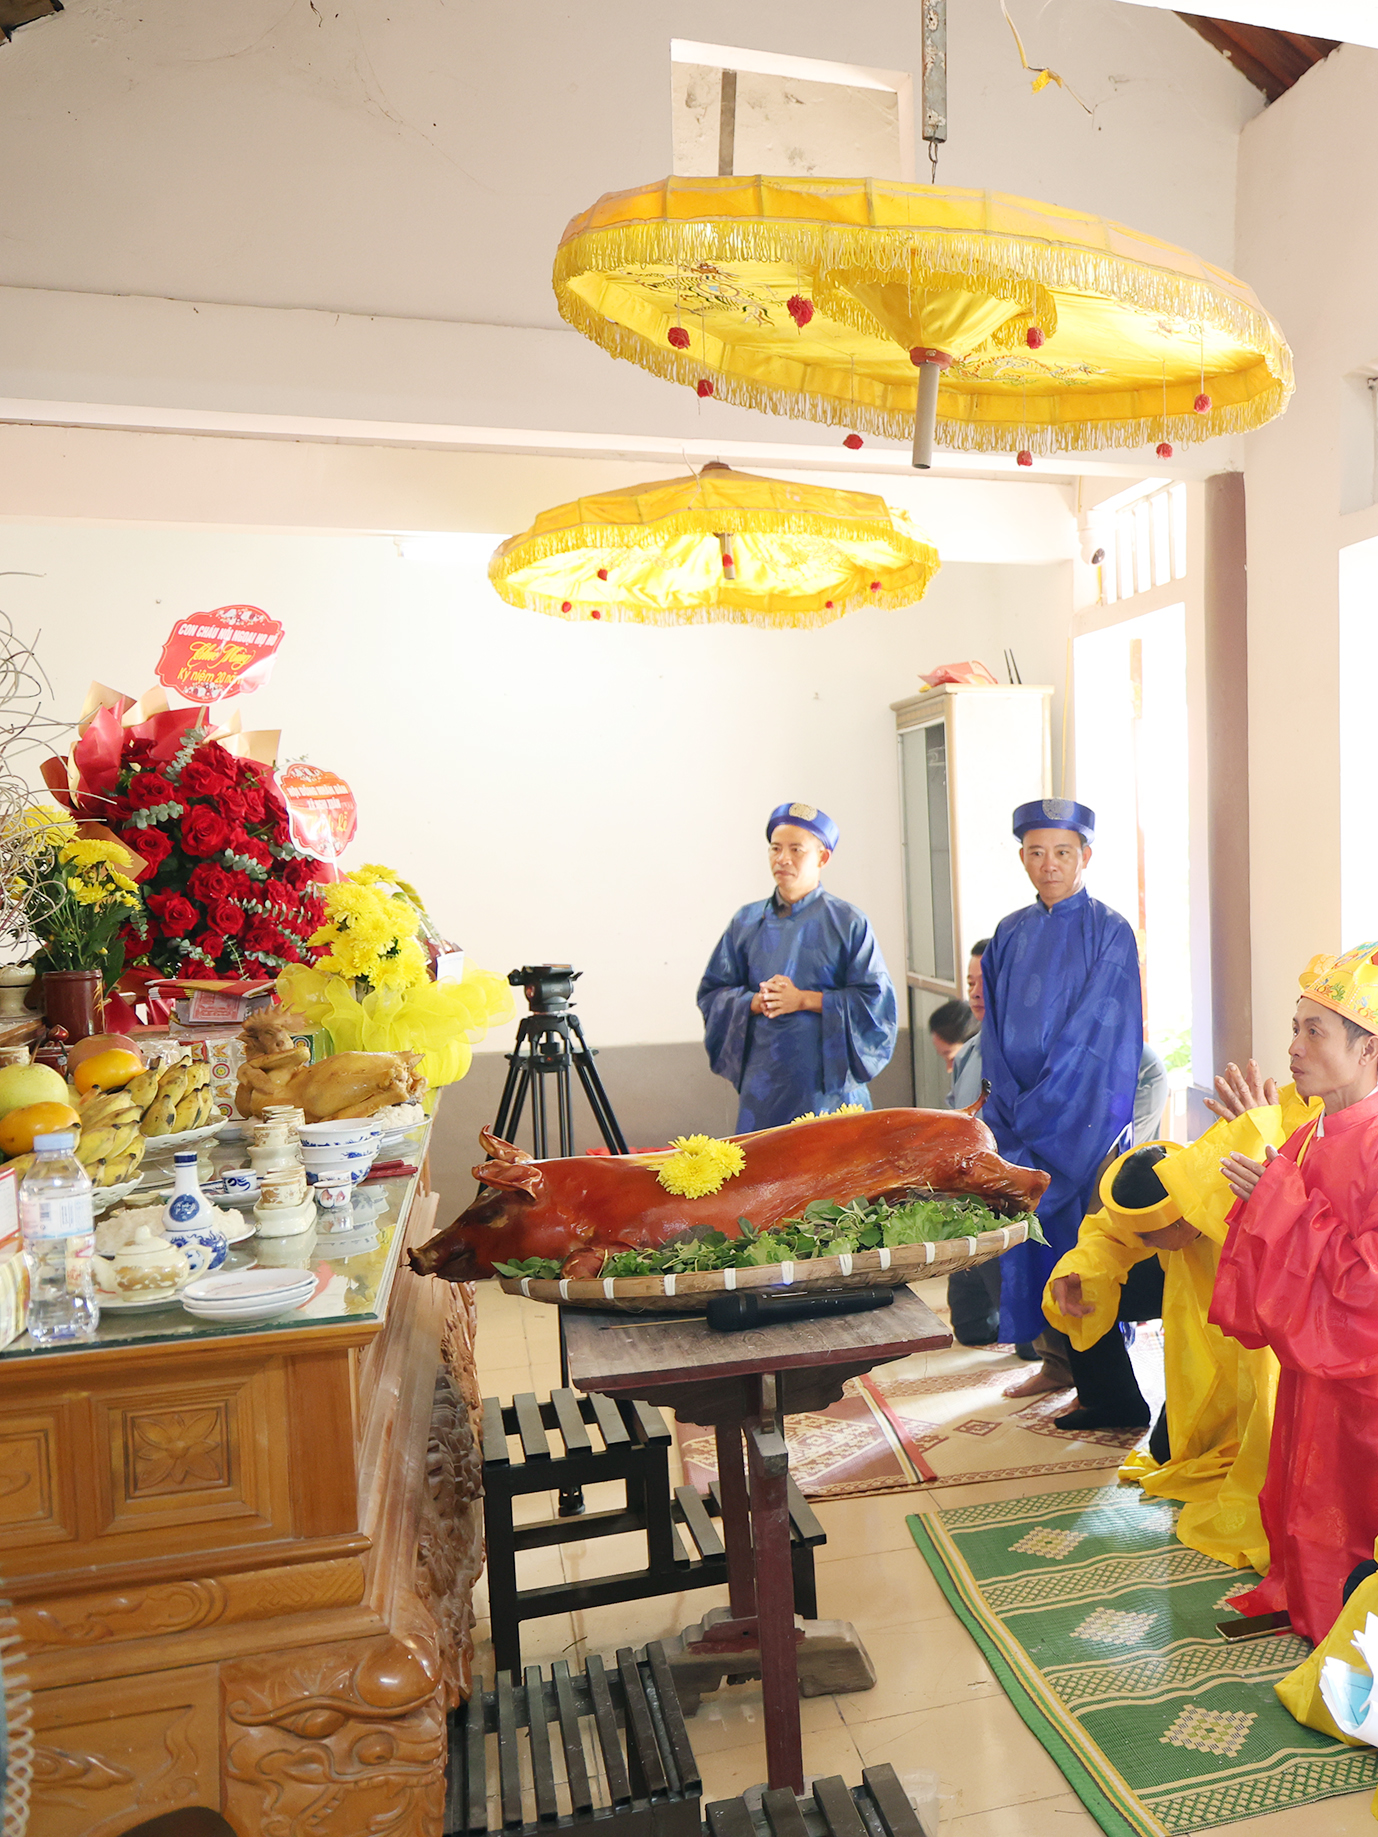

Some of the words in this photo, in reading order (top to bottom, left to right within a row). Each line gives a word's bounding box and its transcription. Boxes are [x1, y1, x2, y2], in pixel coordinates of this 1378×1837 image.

[178, 623, 199, 637] CON
[196, 625, 220, 640] CHÁU
[190, 669, 215, 683] niệm
[214, 671, 226, 684] 20
